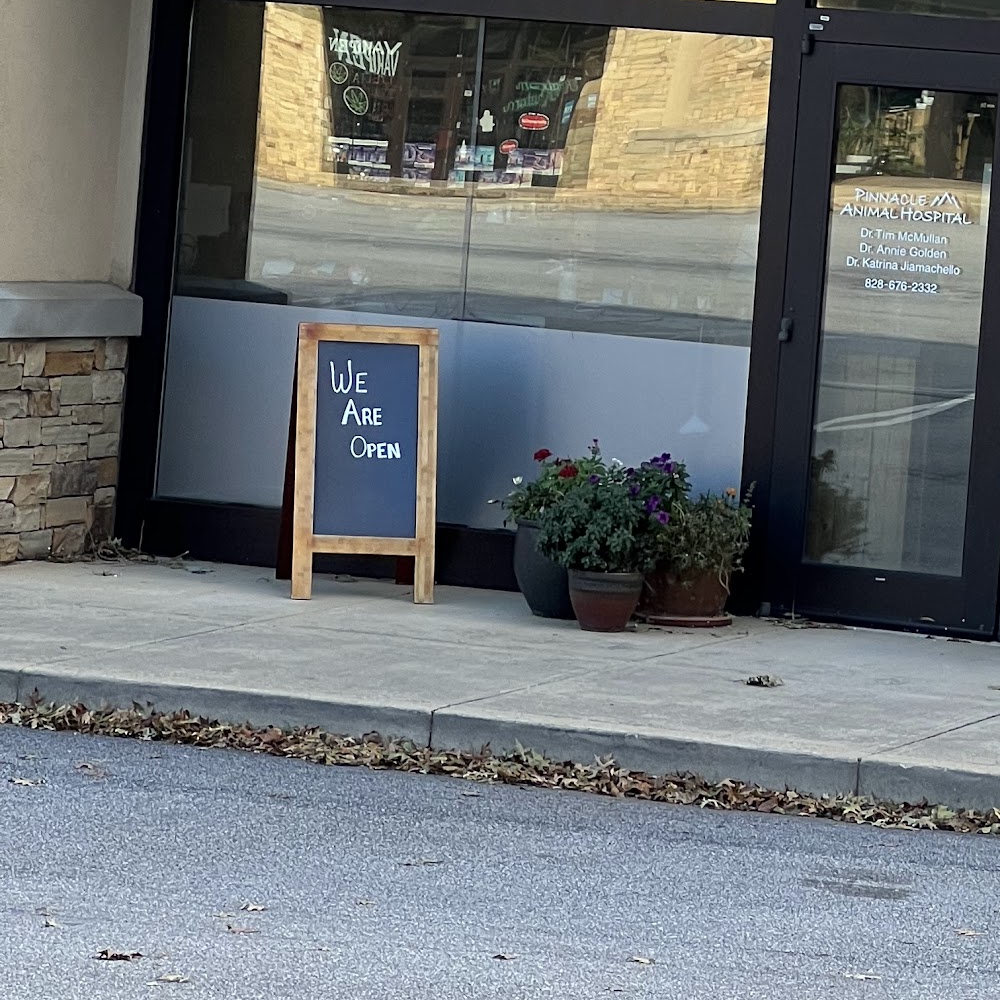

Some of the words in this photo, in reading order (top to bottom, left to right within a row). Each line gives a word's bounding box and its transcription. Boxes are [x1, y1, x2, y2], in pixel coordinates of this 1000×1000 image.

[855, 188, 926, 206] PINNACLE
[840, 203, 898, 219] ANIMAL
[901, 207, 972, 224] HOSPITAL
[860, 228, 873, 238] Dr.
[876, 229, 894, 240] Tim
[898, 231, 948, 244] McMullan
[860, 243, 873, 253] Dr.
[877, 245, 906, 256] Annie
[909, 247, 947, 258] Golden
[846, 256, 860, 267] Dr.
[862, 258, 898, 270] Katrina
[865, 278, 938, 293] 828-676-2332
[329, 359, 368, 394] WE
[341, 399, 383, 426] ARE
[350, 435, 401, 459] OPEN
